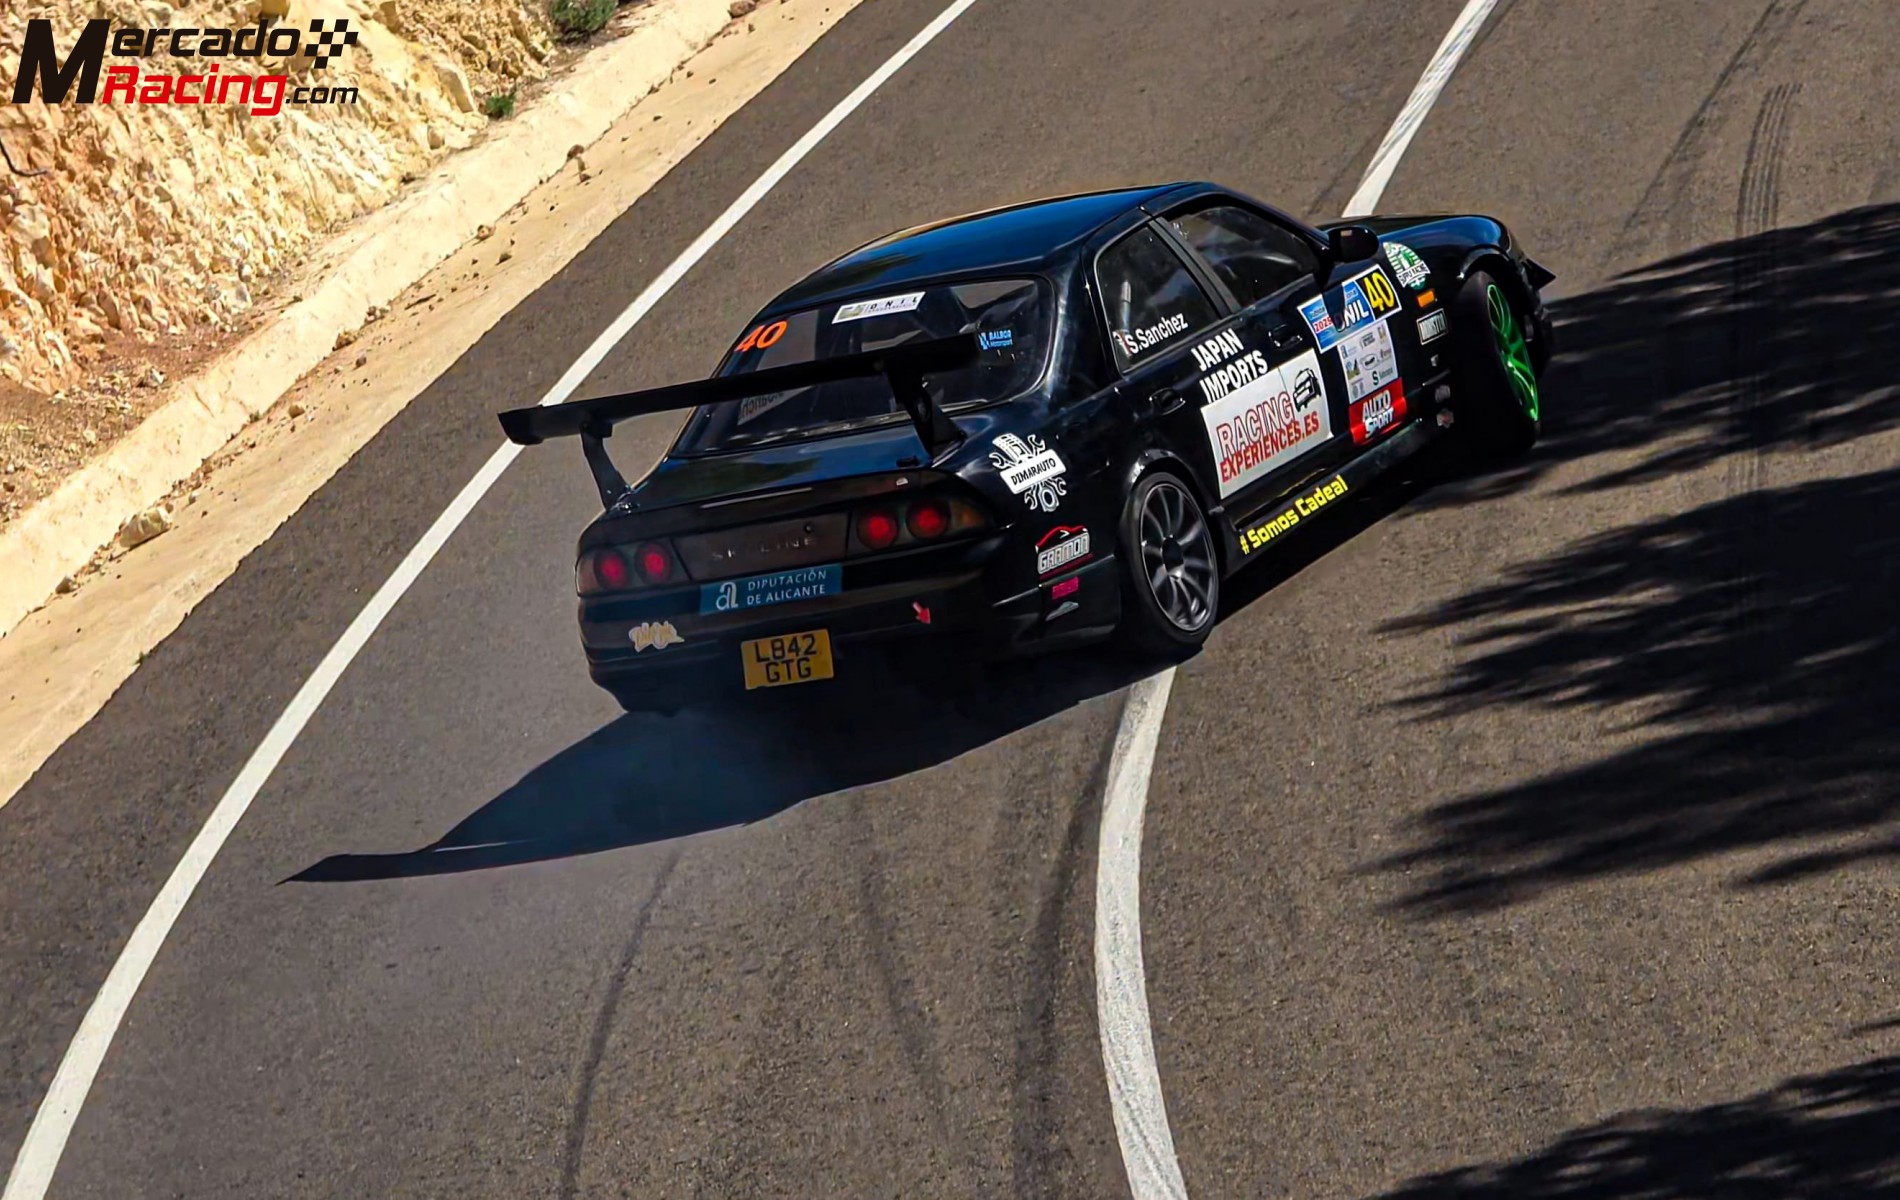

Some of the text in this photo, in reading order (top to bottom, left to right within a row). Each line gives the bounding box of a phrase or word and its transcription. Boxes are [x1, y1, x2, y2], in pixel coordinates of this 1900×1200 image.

[1363, 272, 1395, 312] 40
[733, 320, 788, 352] 40
[1190, 327, 1245, 373] JAPAN
[1199, 349, 1269, 405] IMPORTS
[1362, 389, 1392, 422] AUTO
[1216, 391, 1296, 461] RACING
[1219, 411, 1320, 482] EXPERIENCES.ES
[1010, 457, 1057, 486] DIMARAUTO
[1295, 474, 1349, 517] Cadeal
[746, 583, 826, 606] DE ALICANTE
[765, 656, 812, 684] GTG
